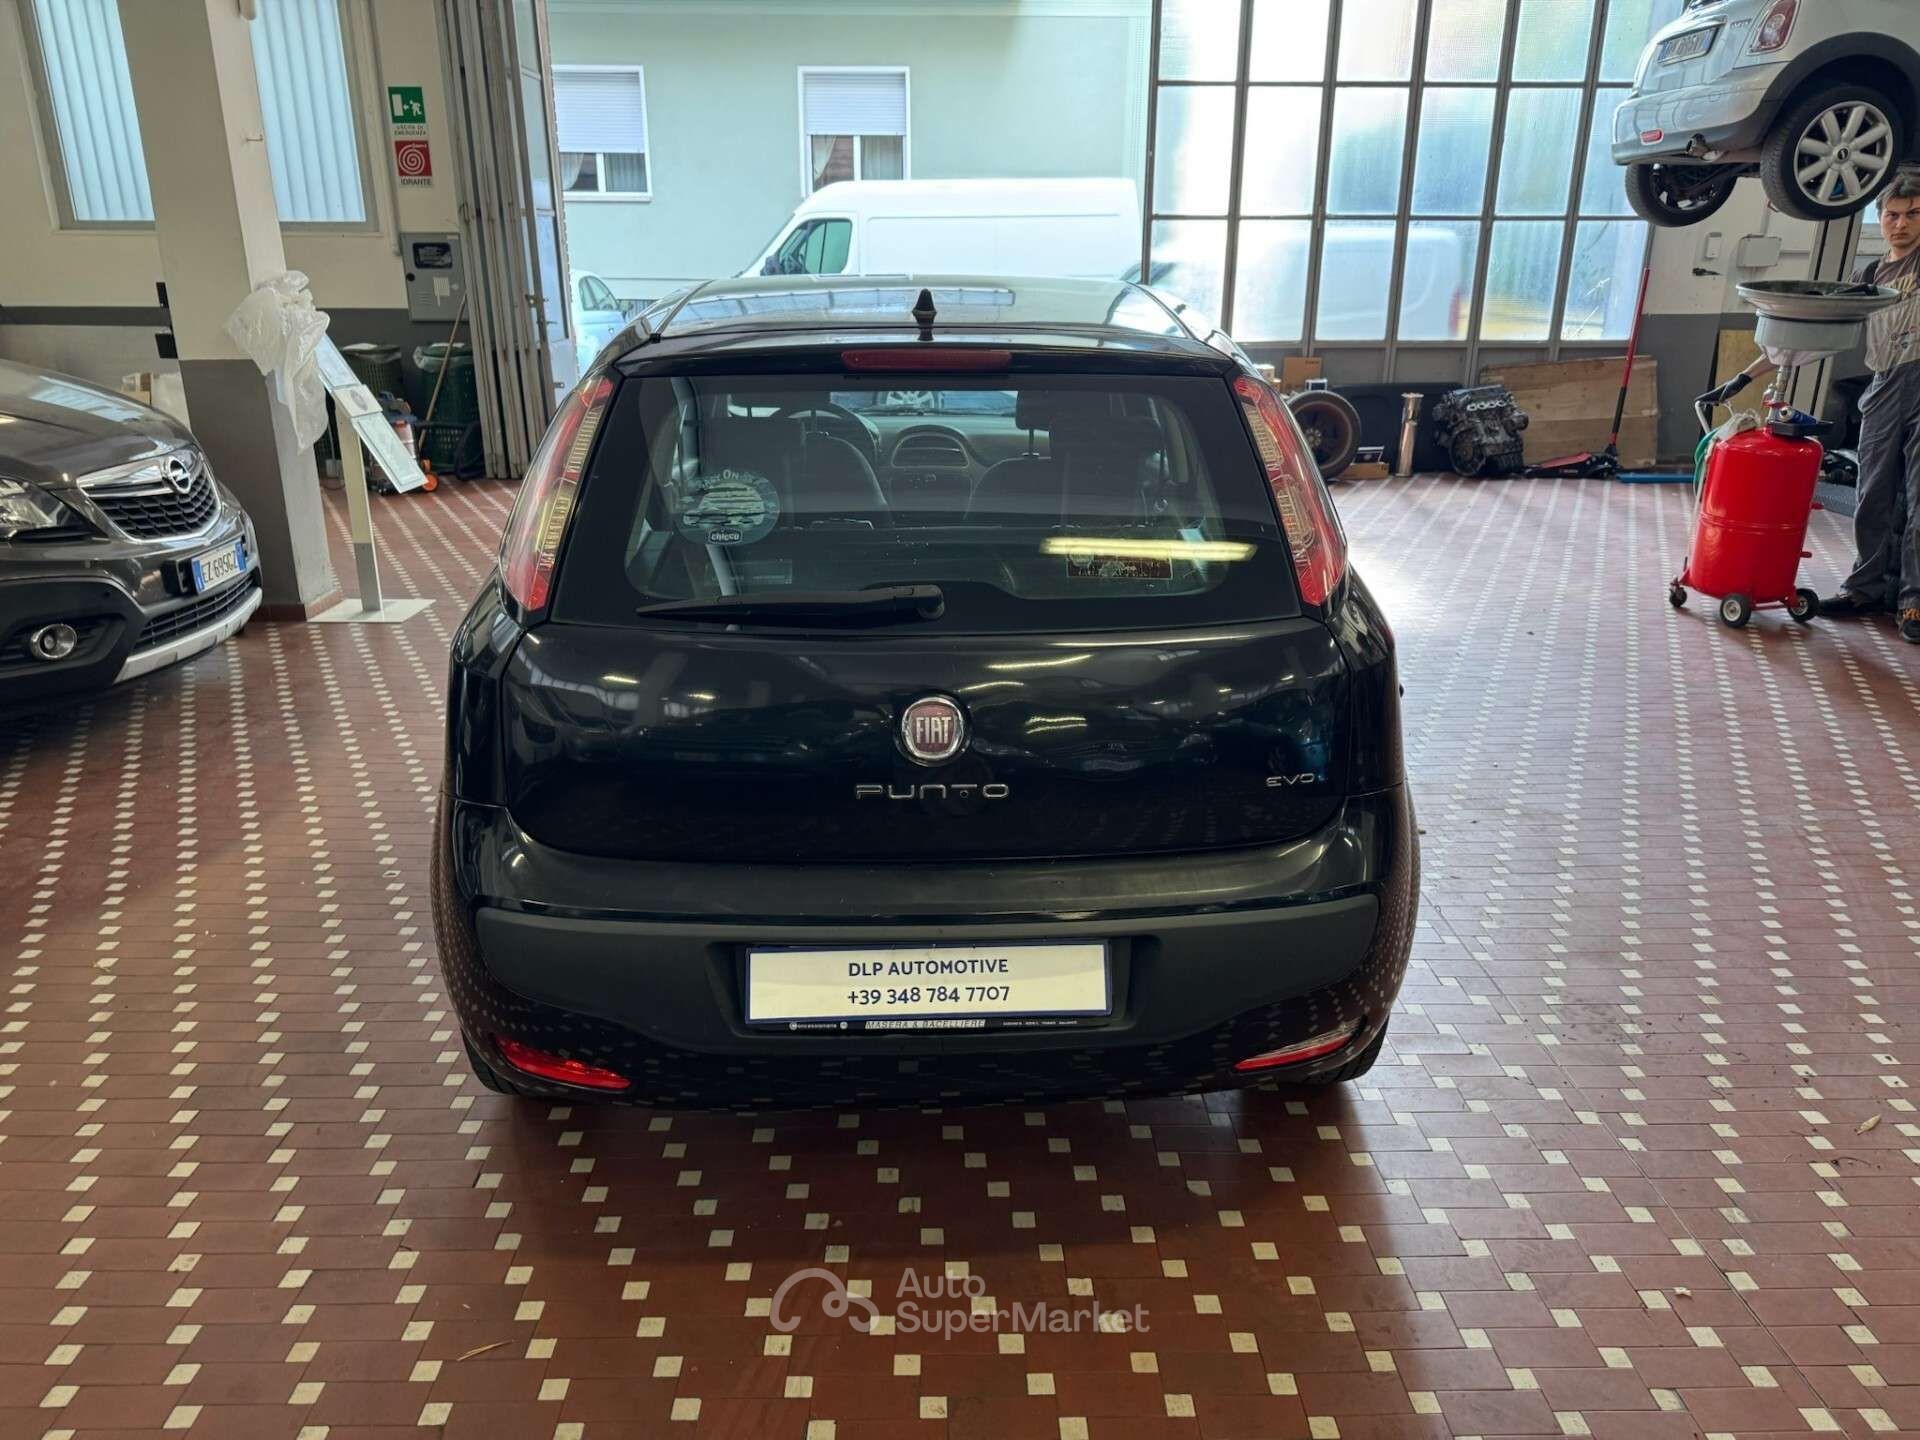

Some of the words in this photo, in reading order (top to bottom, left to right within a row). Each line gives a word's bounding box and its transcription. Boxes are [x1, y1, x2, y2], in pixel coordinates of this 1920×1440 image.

[722, 468, 739, 480] ON
[711, 532, 740, 541] chicco
[914, 714, 953, 744] FIAT
[1265, 772, 1316, 787] EVO
[855, 782, 1010, 799] PUNTO
[848, 961, 883, 977] DLP
[887, 959, 1009, 976] AUTOMOTIVE
[847, 988, 882, 1006] +39
[886, 987, 921, 1005] 348
[926, 986, 960, 1003] 784
[965, 985, 1010, 1002] 7707
